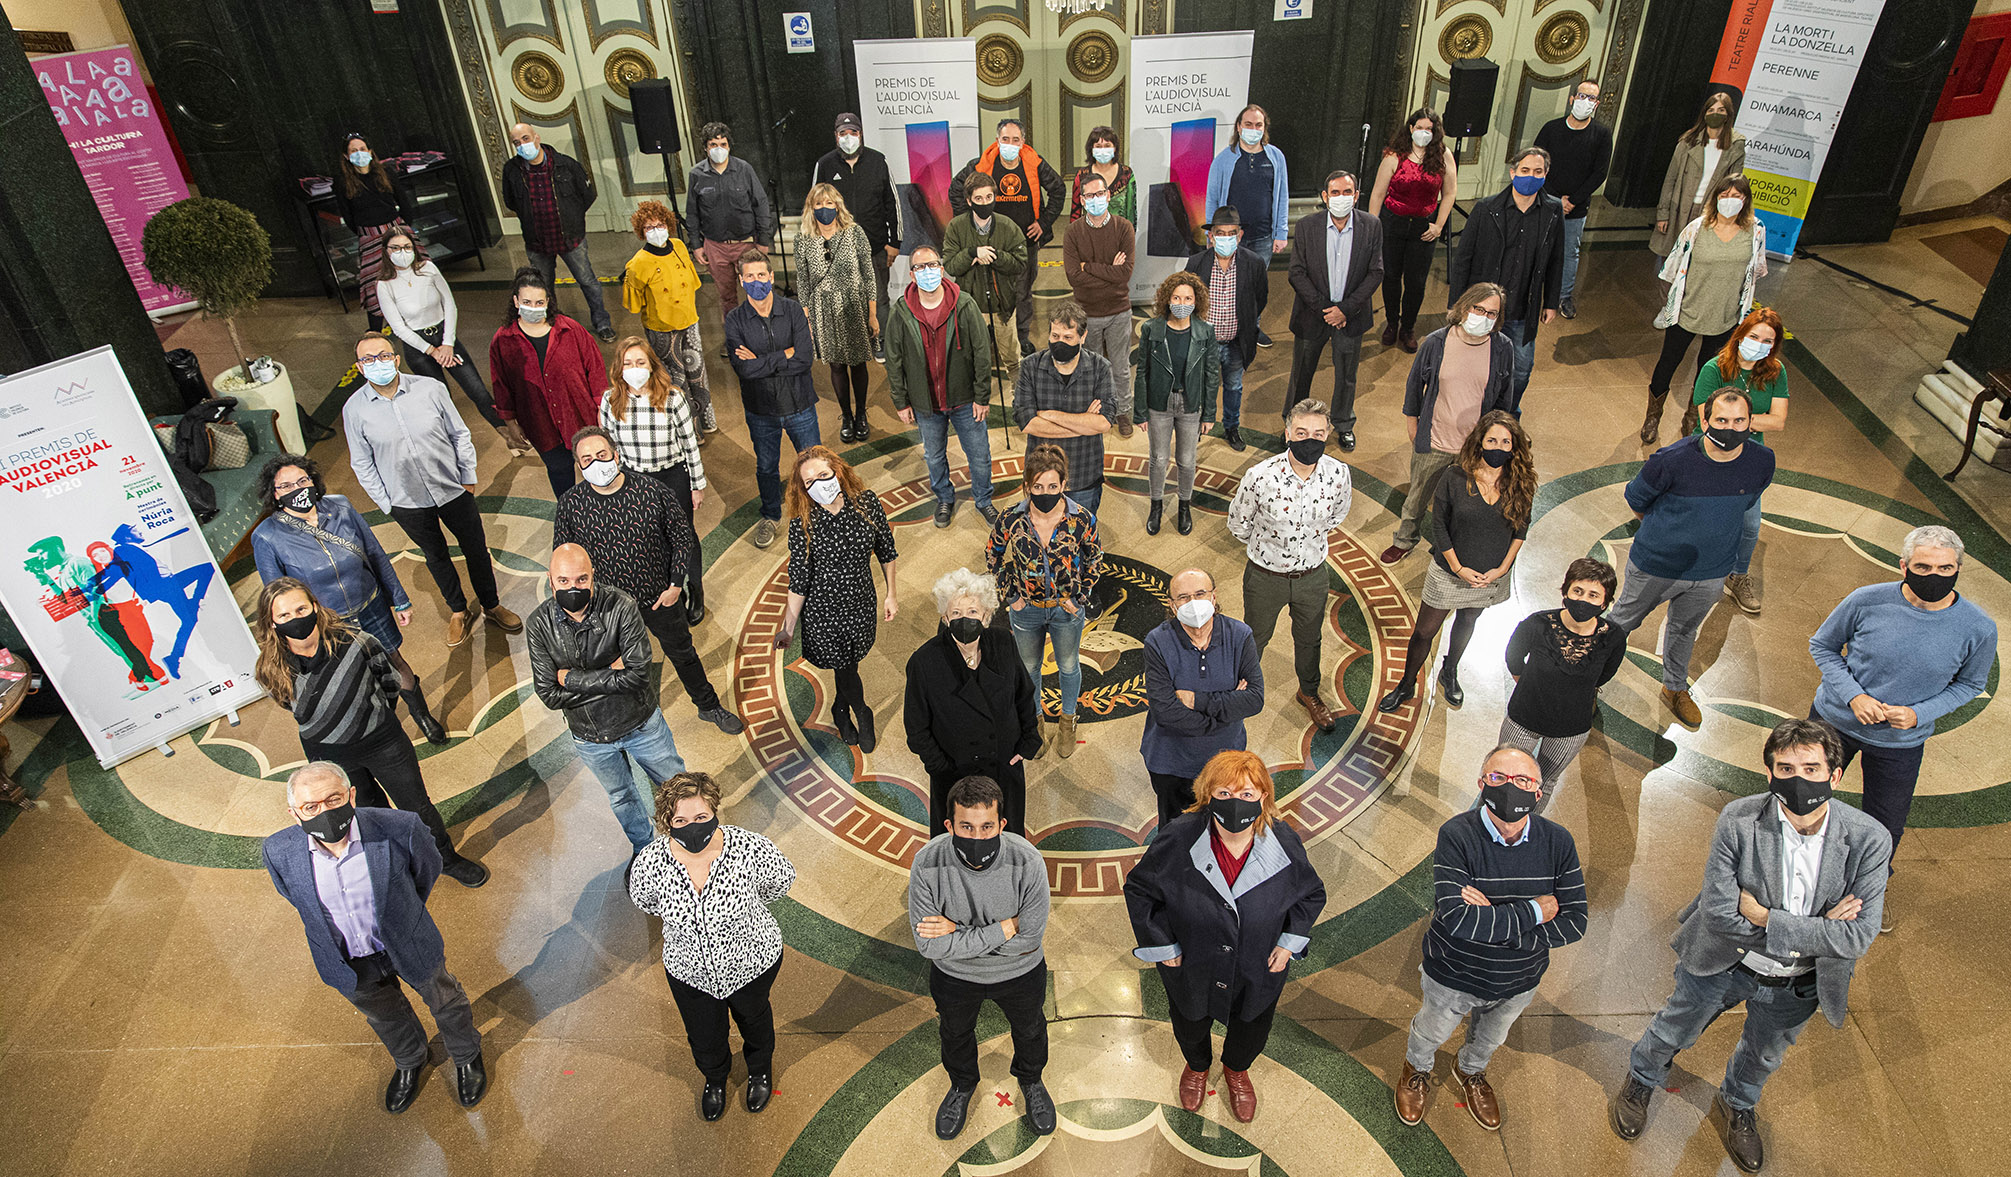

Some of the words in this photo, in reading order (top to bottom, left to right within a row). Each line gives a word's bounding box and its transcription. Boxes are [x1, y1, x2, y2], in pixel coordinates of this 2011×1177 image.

[1775, 22, 1790, 34] LA
[1792, 25, 1830, 39] MORT
[1728, 27, 1750, 71] TEATRE
[1771, 35, 1786, 45] LA
[1789, 37, 1855, 55] DONZELLA
[1145, 74, 1188, 87] PREMIS
[1191, 73, 1207, 84] DE
[1762, 62, 1820, 81] PERENNE
[874, 77, 917, 88] PREMIS
[920, 77, 935, 87] DE
[876, 90, 960, 102] L'AUDIOVISUAL
[1145, 87, 1231, 101] L'AUDIOVISUAL
[877, 101, 934, 115] VALENCIÀ
[1145, 98, 1202, 114] VALENCIÀ
[1750, 100, 1822, 122] DINAMARCA
[80, 139, 94, 147] LA
[94, 130, 144, 144] CULTURA
[83, 141, 126, 154] TARDOR
[1745, 139, 1811, 160] ARAHÚNDA
[1748, 178, 1798, 196] PORADA
[1752, 191, 1790, 206] HIBICIÓ
[8, 437, 73, 466] PREMIS
[74, 428, 98, 444] DE
[0, 439, 113, 487] AUDIOVISUAL
[121, 455, 136, 466] 21
[12, 456, 98, 493] VALENCIÀ
[41, 477, 83, 499] 2020
[125, 490, 135, 500] À
[136, 482, 163, 498] punt
[141, 507, 173, 522] Núria
[146, 516, 175, 529] Roca
